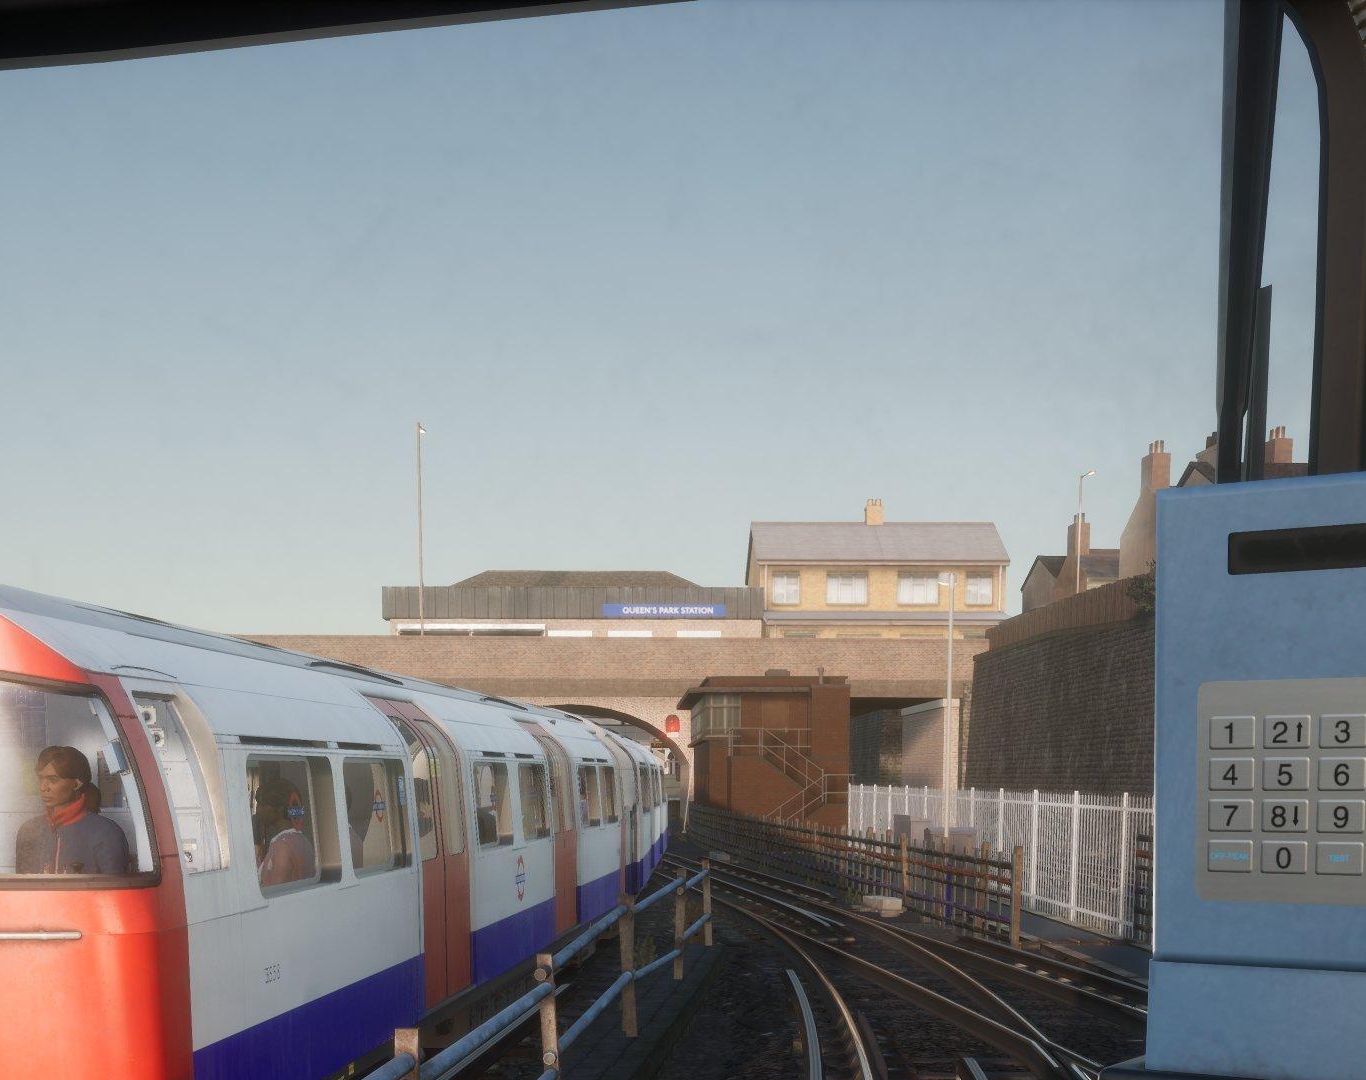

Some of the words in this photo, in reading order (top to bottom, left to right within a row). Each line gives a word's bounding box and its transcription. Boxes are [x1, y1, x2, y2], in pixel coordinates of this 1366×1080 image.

[622, 605, 658, 615] QUEEN'S
[659, 605, 679, 615] PARK
[680, 605, 714, 615] STATION
[1223, 721, 1234, 744] 1
[1272, 721, 1288, 744] 2
[1334, 720, 1351, 744] 3
[1222, 763, 1238, 786] 4
[1277, 763, 1293, 787] 5
[1333, 763, 1350, 787] 6
[1223, 805, 1239, 827] 7
[1270, 805, 1287, 828] 8
[1333, 806, 1349, 828] 9
[1275, 847, 1292, 869] 0
[1328, 854, 1350, 863] TEST
